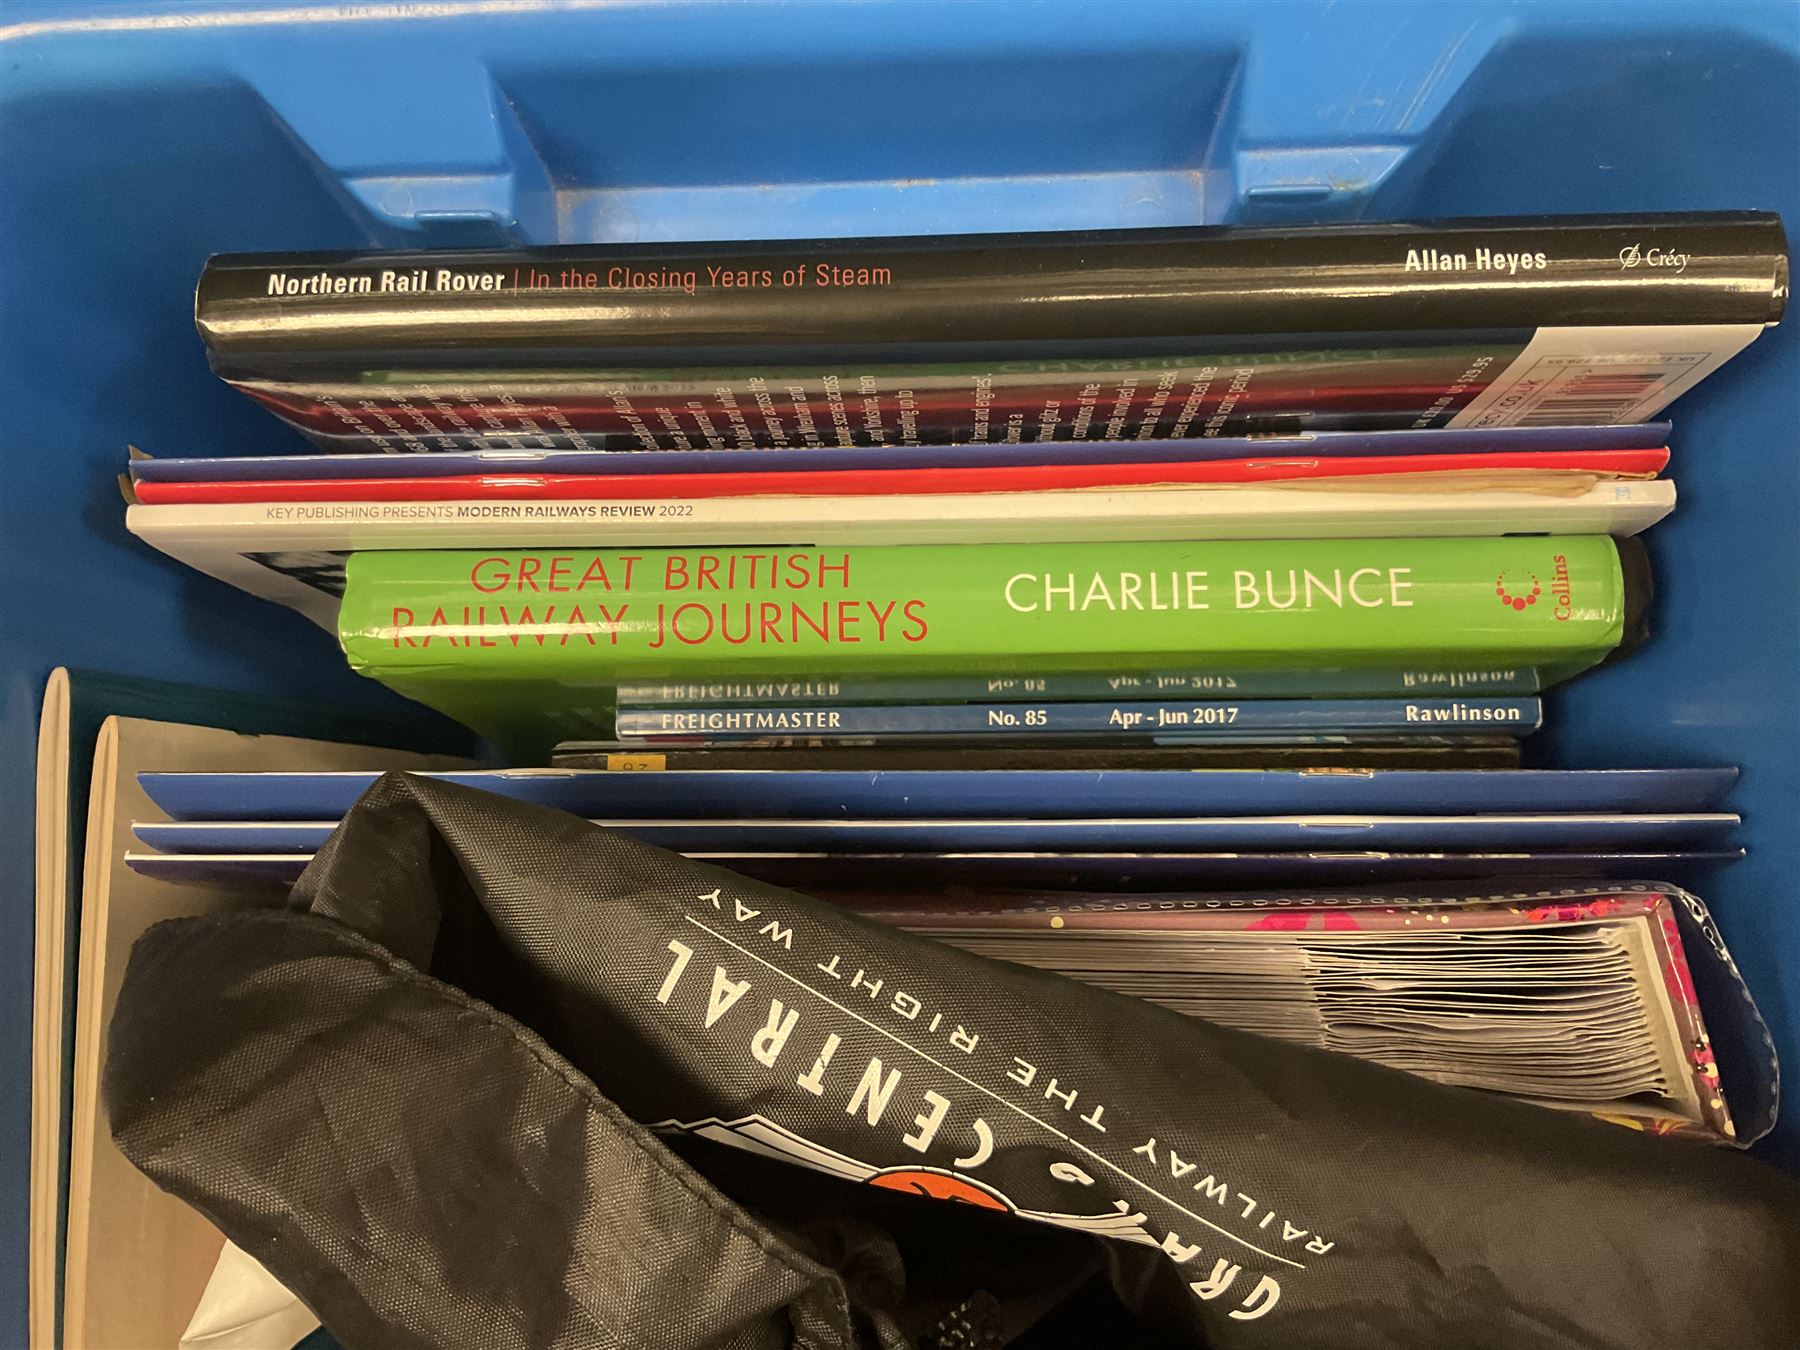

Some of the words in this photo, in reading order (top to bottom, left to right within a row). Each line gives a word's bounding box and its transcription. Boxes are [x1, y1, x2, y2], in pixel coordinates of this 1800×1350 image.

[1404, 250, 1467, 271] Allan
[1475, 248, 1547, 275] Heyes
[1646, 248, 1691, 273] Crécy
[268, 273, 371, 295] Northern
[381, 271, 427, 292] Rail
[437, 270, 505, 292] Rover
[530, 269, 549, 289] In
[560, 268, 597, 289] the
[608, 267, 696, 293] Closing
[707, 266, 772, 287] Years
[782, 265, 806, 287] of
[816, 264, 892, 287] Steam
[857, 375, 878, 395] then
[1157, 370, 1181, 391] seek
[1194, 366, 1219, 382] the
[1456, 356, 1494, 383] $29.95
[823, 375, 844, 401] across
[267, 507, 294, 519] KEY
[297, 506, 379, 518] PUBLISHING
[383, 506, 453, 518] PRESENTS
[457, 506, 521, 517] MODERN
[525, 506, 597, 517] RAILWAYS
[600, 505, 655, 517] REVIEW
[659, 505, 693, 516] 2022
[471, 556, 643, 594] GREAT
[664, 554, 850, 591] BRITISH
[1552, 555, 1571, 621] Collins
[1004, 571, 1209, 612] CHARLIE
[1235, 568, 1413, 609] BUNCE
[393, 604, 630, 648] RAILWAY
[649, 600, 928, 648] JOURNEYS
[662, 711, 841, 729] FREIGHTMASTER
[988, 710, 1021, 726] No.
[1025, 709, 1047, 726] 85
[1110, 708, 1143, 729] Apr
[1159, 708, 1188, 726] Jun
[1193, 708, 1239, 725] 2017
[1406, 705, 1520, 722] Rawlinson
[697, 889, 794, 950] WAY
[817, 954, 980, 1054] RIGHT
[656, 940, 994, 1168] CENTRAL
[1006, 1055, 1107, 1132] THE
[1133, 1137, 1335, 1255] RAILWAY
